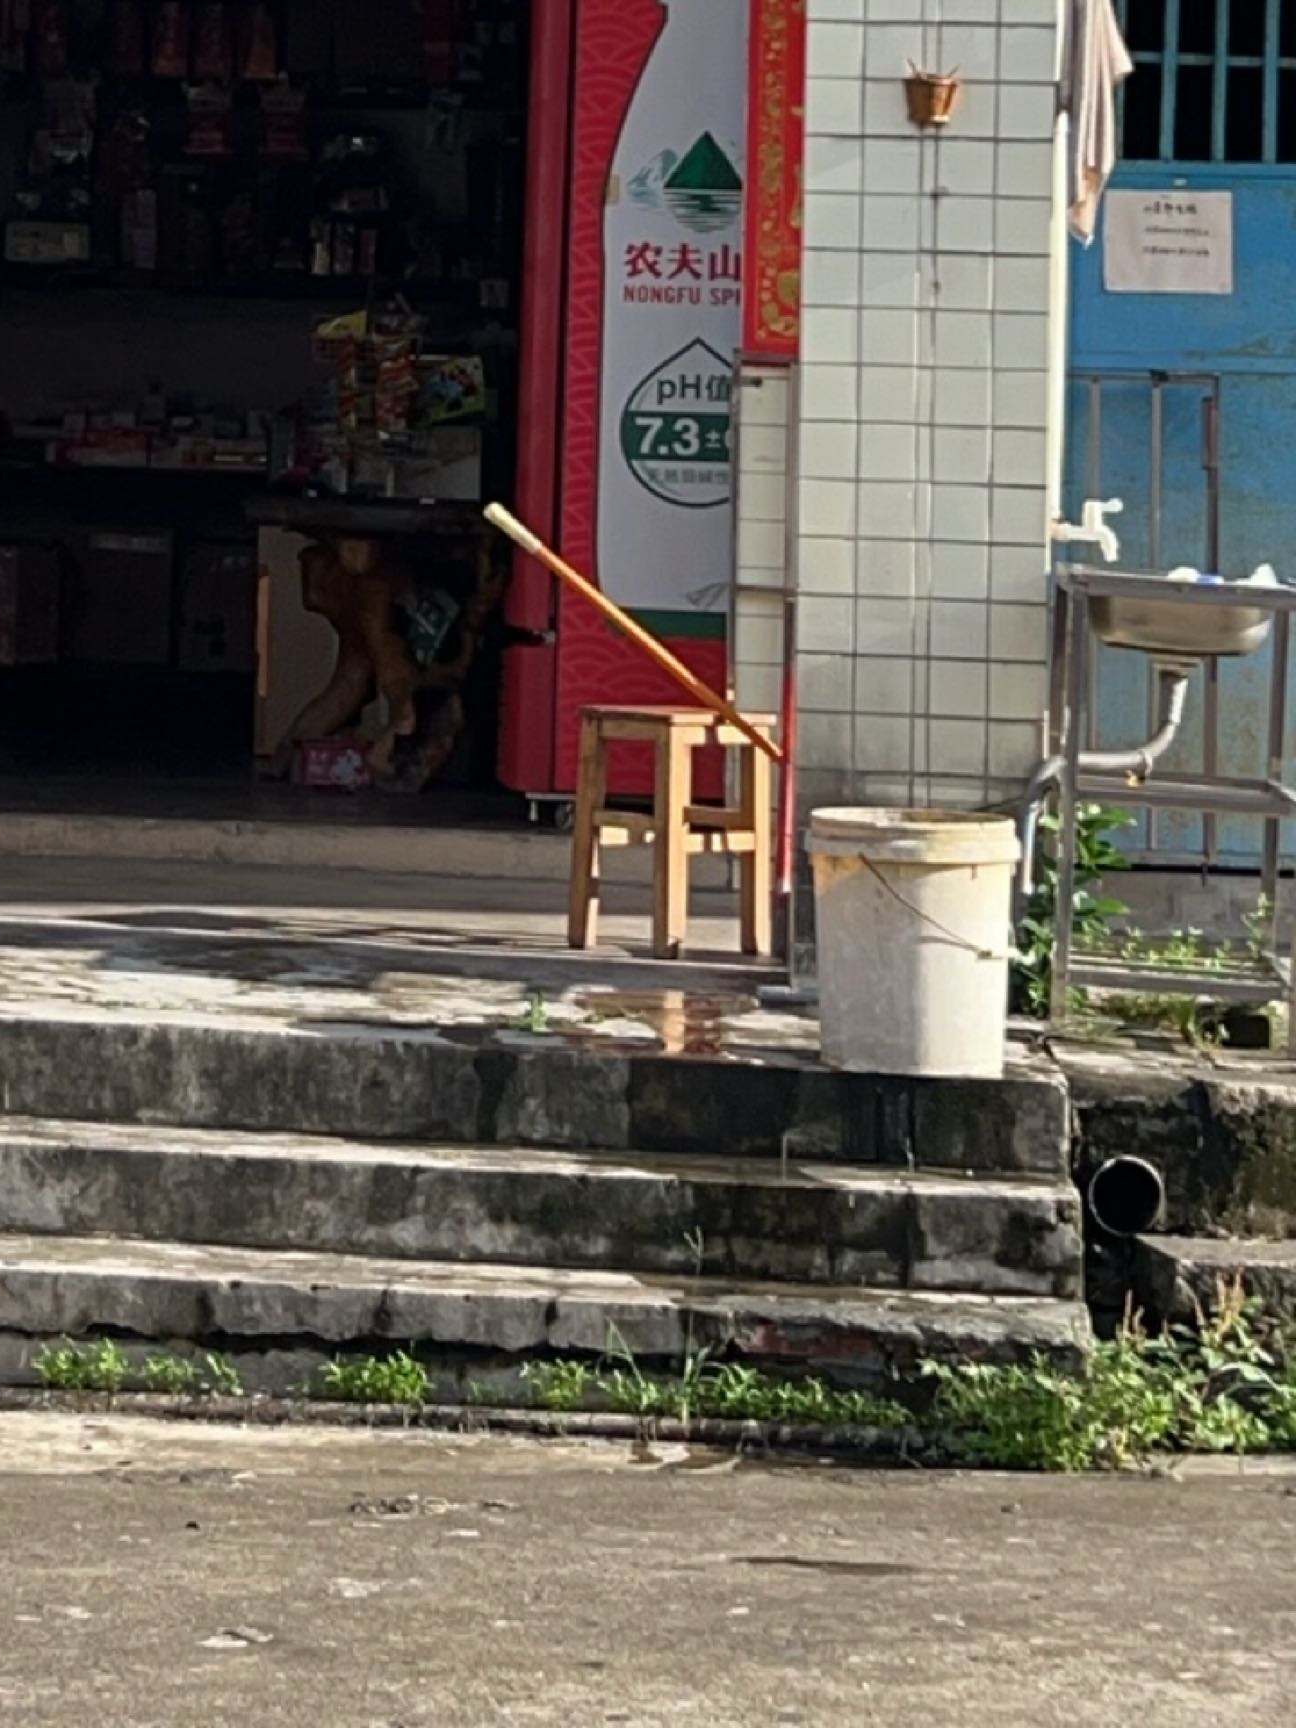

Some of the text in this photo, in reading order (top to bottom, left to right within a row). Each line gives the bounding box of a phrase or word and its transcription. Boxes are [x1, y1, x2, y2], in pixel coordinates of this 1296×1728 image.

[624, 241, 740, 282] 农夫山
[623, 285, 701, 305] NONGFU
[634, 417, 731, 457] 7.3±
